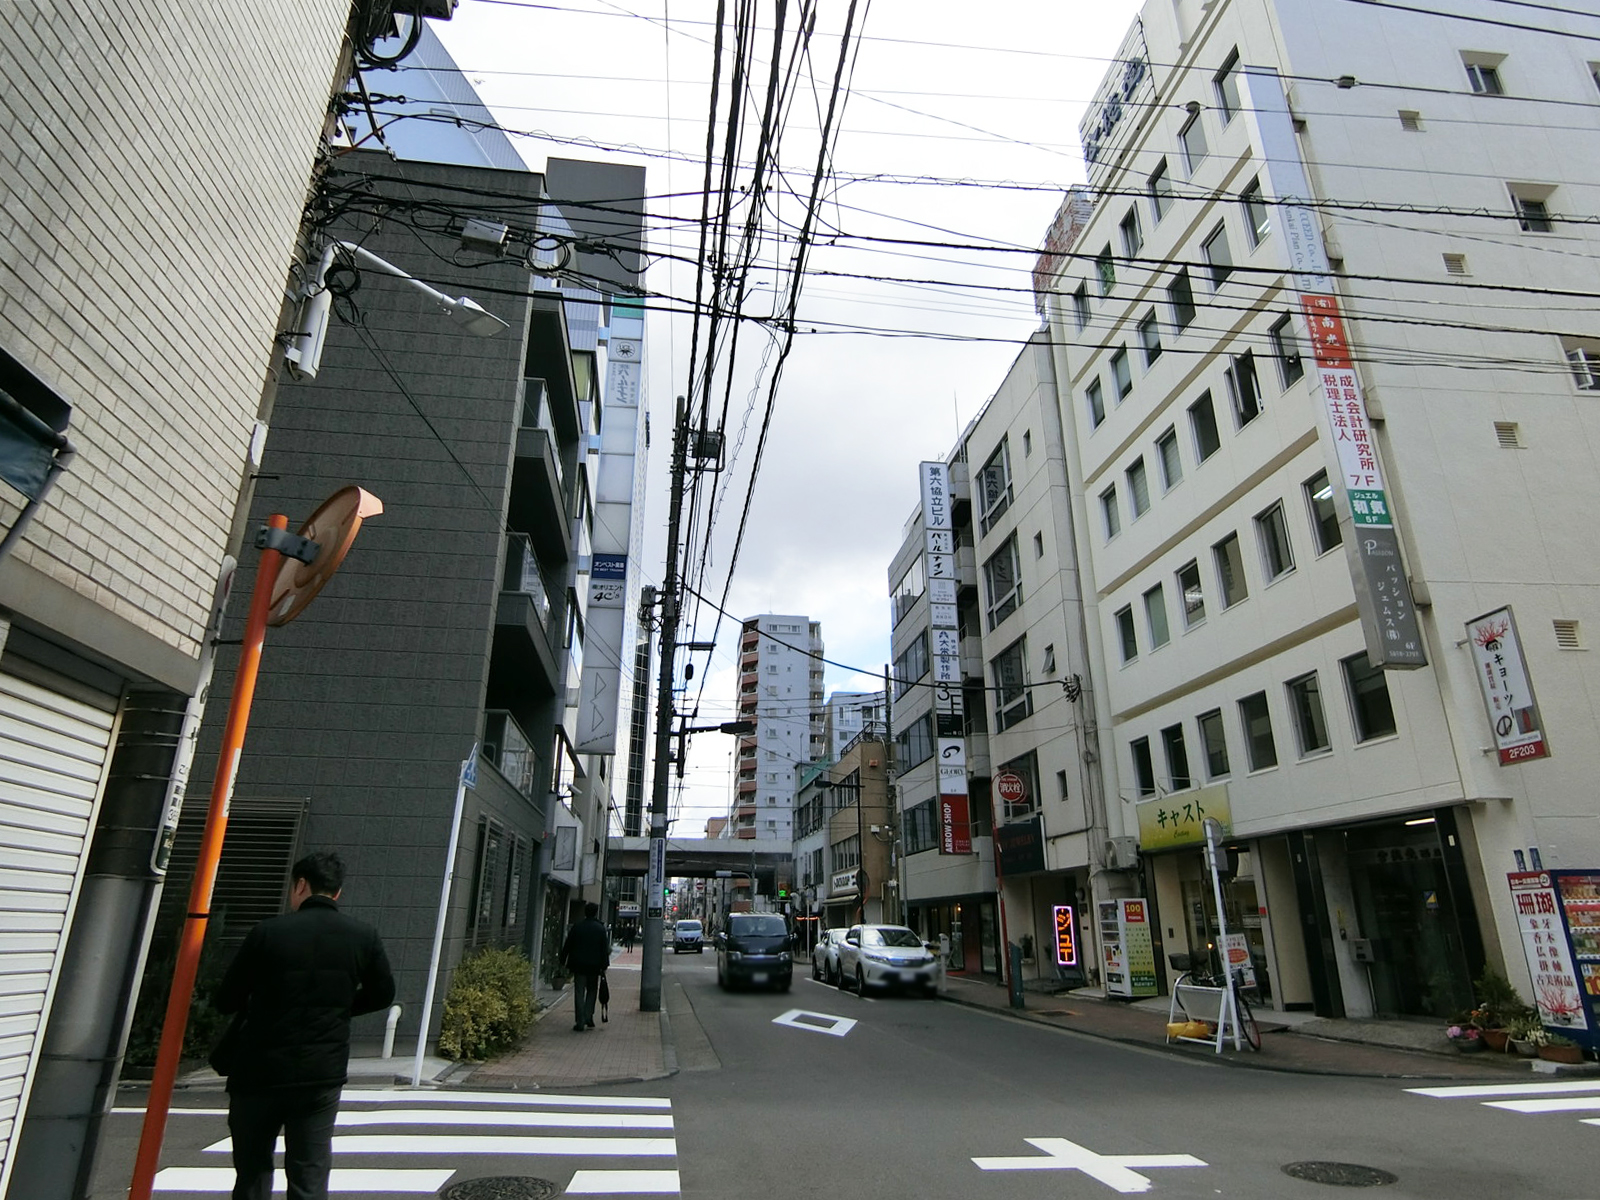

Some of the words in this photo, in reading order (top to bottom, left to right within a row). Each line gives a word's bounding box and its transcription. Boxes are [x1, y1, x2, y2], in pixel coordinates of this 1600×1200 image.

[1323, 374, 1351, 442] 税理士法人
[1339, 374, 1375, 471] 成長会計研究所
[1350, 474, 1375, 487] 7F
[929, 466, 945, 526] 第六協立ビル
[1354, 492, 1379, 500] ジュエル
[1365, 515, 1379, 524] 5F
[1509, 744, 1536, 759] 2F203
[1000, 782, 1021, 794] 消火栓
[943, 803, 952, 824] SHOP
[1157, 800, 1205, 829] キャスト
[944, 824, 954, 853] ARROW
[1125, 904, 1141, 913] 100
